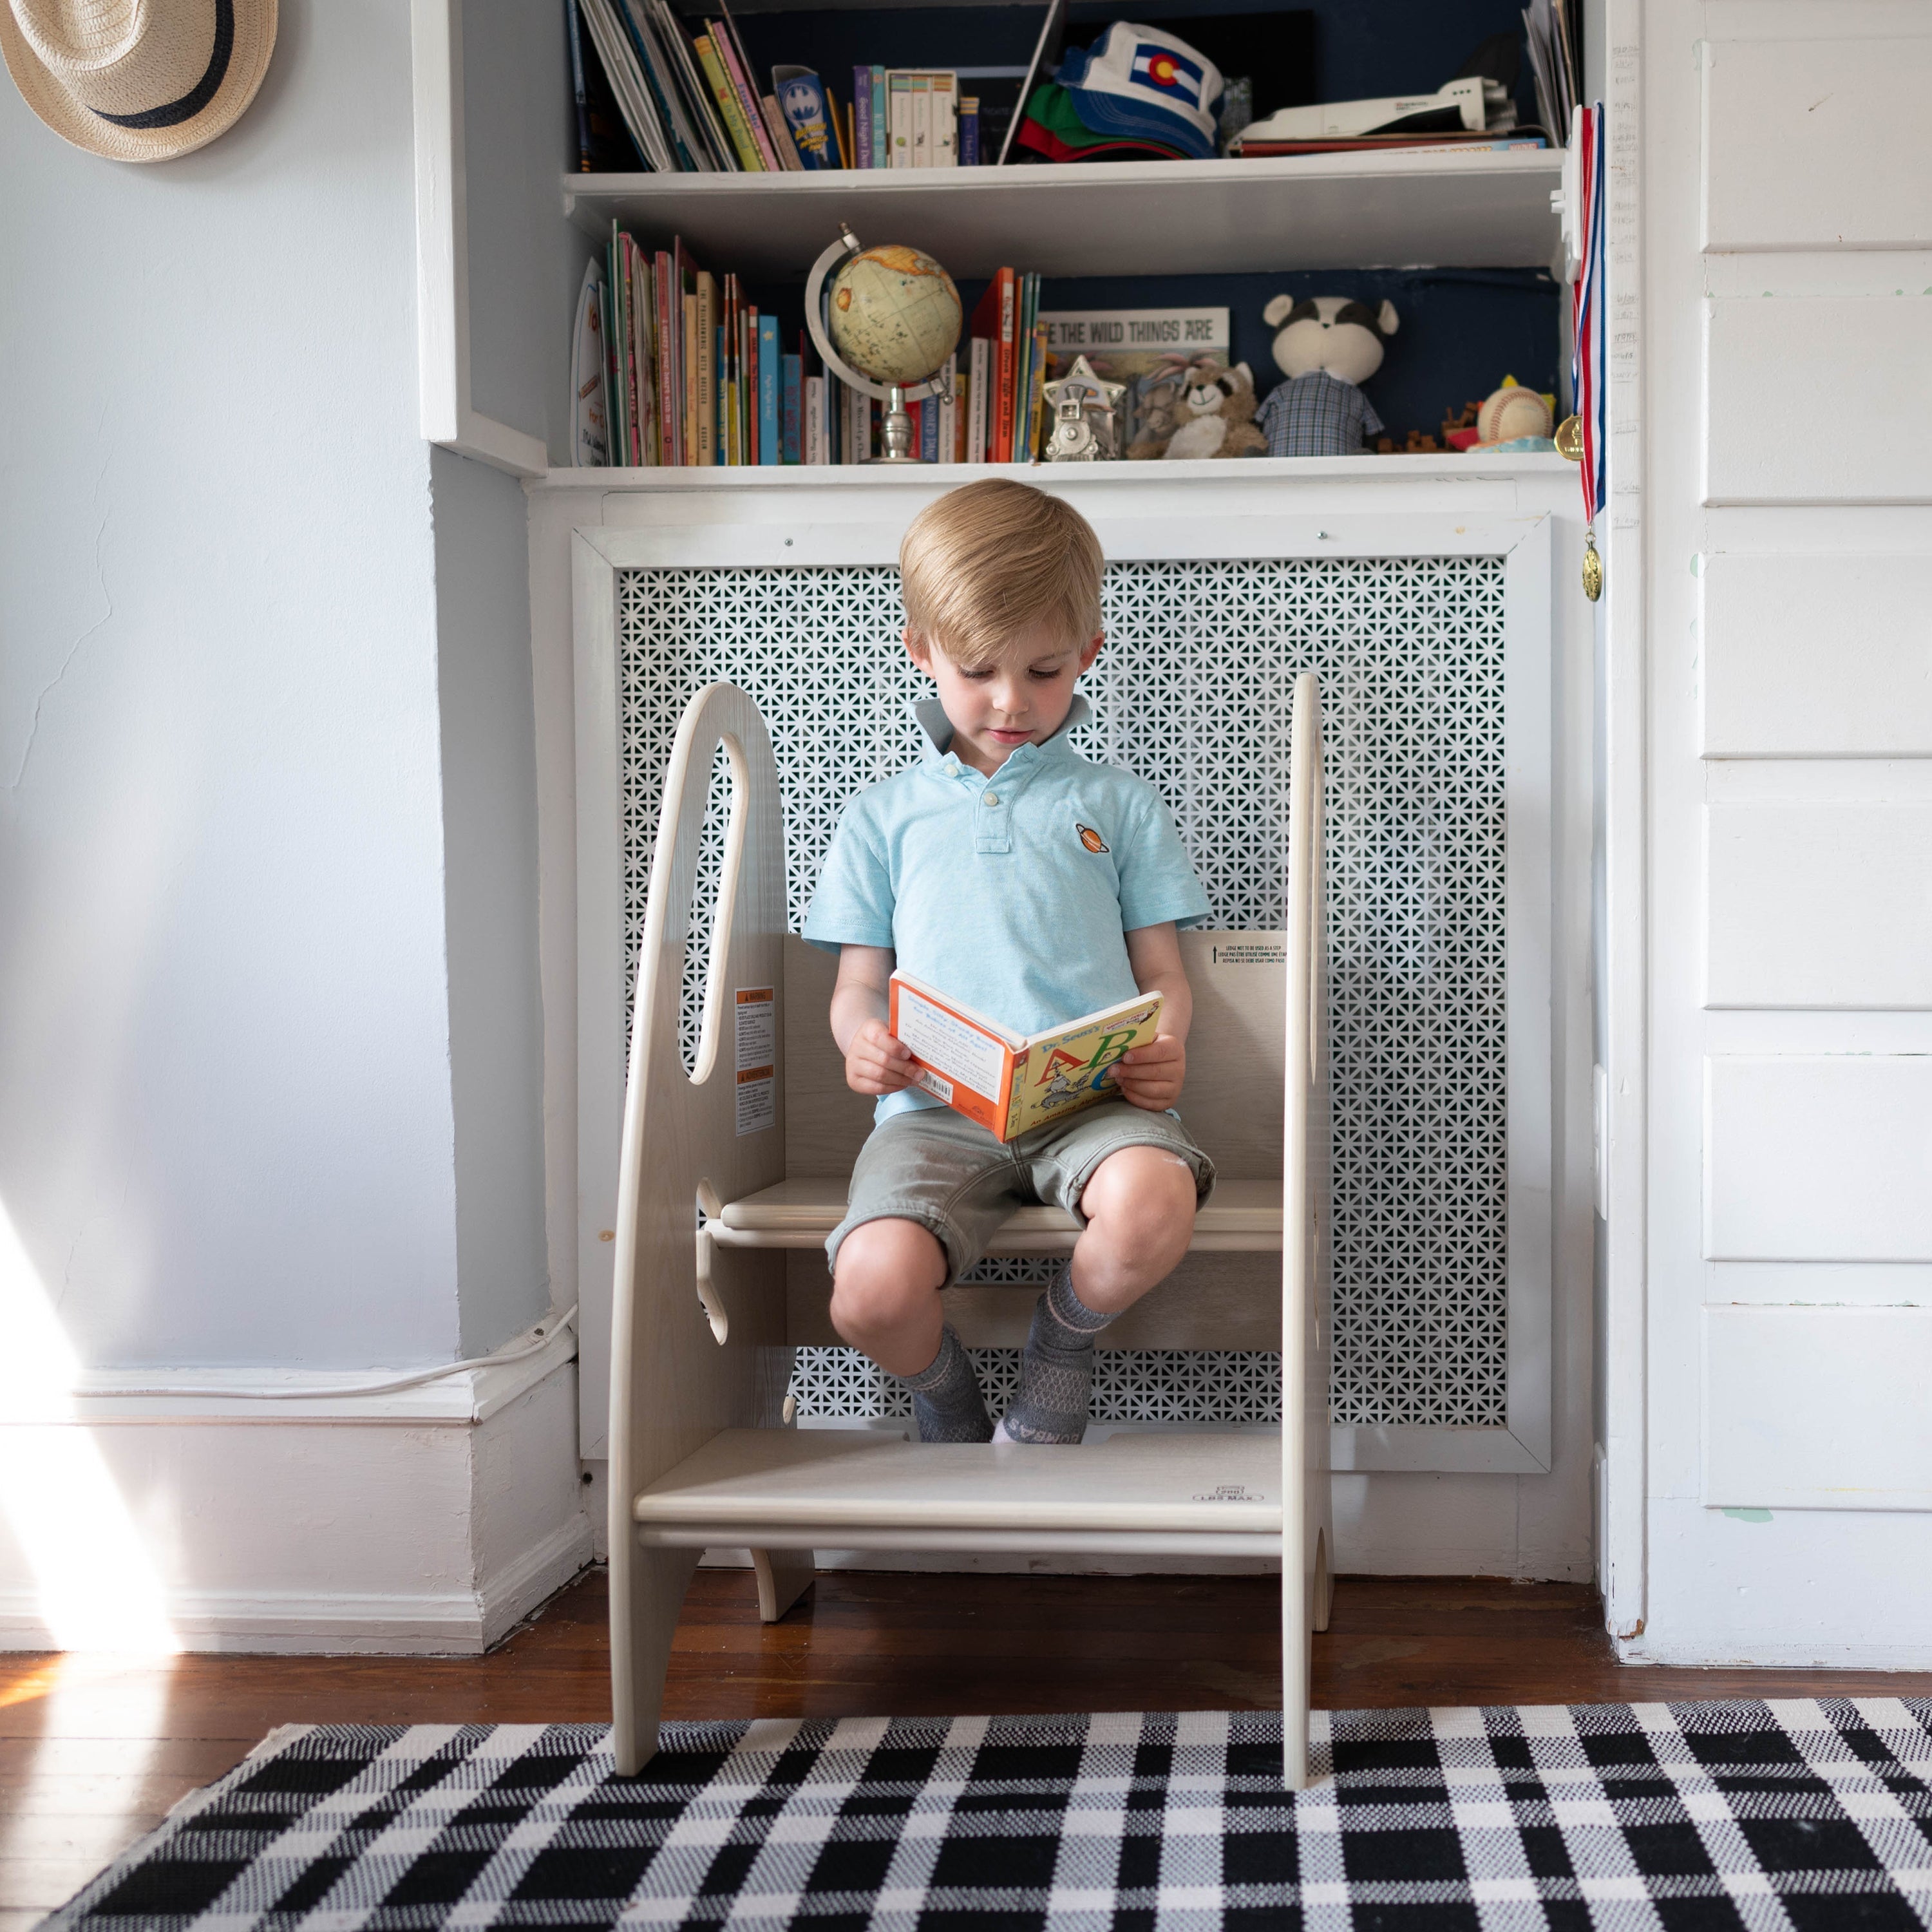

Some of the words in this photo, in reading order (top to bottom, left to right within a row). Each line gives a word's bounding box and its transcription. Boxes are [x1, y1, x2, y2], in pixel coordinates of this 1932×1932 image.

[858, 122, 869, 147] Night
[1060, 322, 1085, 344] THE
[1090, 321, 1124, 343] WILD
[1128, 319, 1180, 343] THINGS
[1184, 319, 1213, 341] ARE
[662, 350, 670, 368] your
[663, 372, 672, 393] heart
[1002, 378, 1012, 397] Eggs
[665, 413, 671, 424] me
[750, 992, 766, 1001] WARNING
[1042, 1042, 1059, 1054] Dr.
[1062, 1025, 1101, 1045] Seuss's
[1044, 1105, 1076, 1121] Amazing
